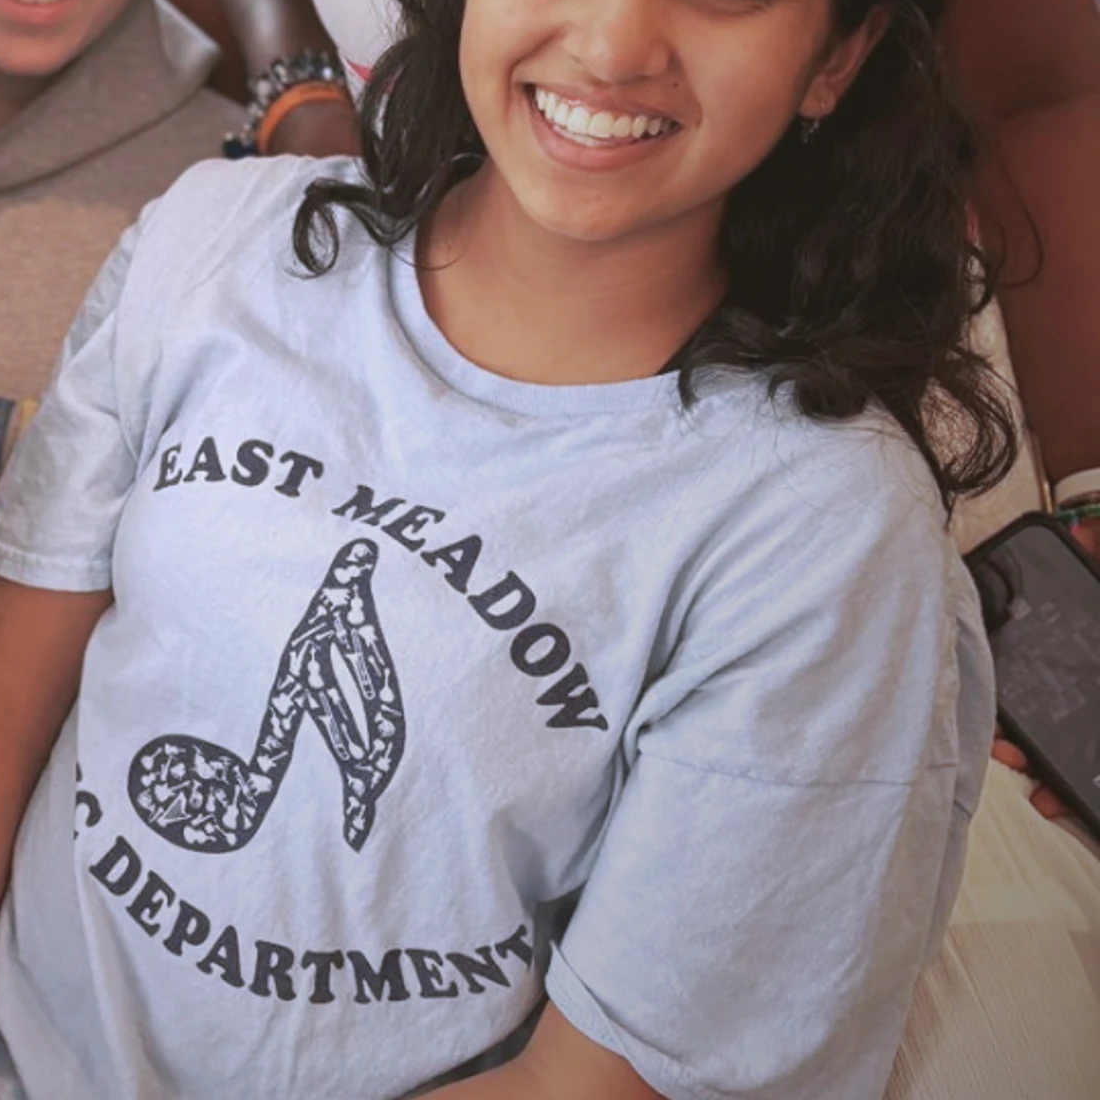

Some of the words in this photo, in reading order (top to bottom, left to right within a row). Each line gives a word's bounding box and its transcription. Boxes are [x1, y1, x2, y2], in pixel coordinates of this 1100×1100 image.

[153, 436, 324, 497] EAST
[331, 485, 609, 732] MEADOW
[88, 835, 534, 1004] DEPARTMENT
